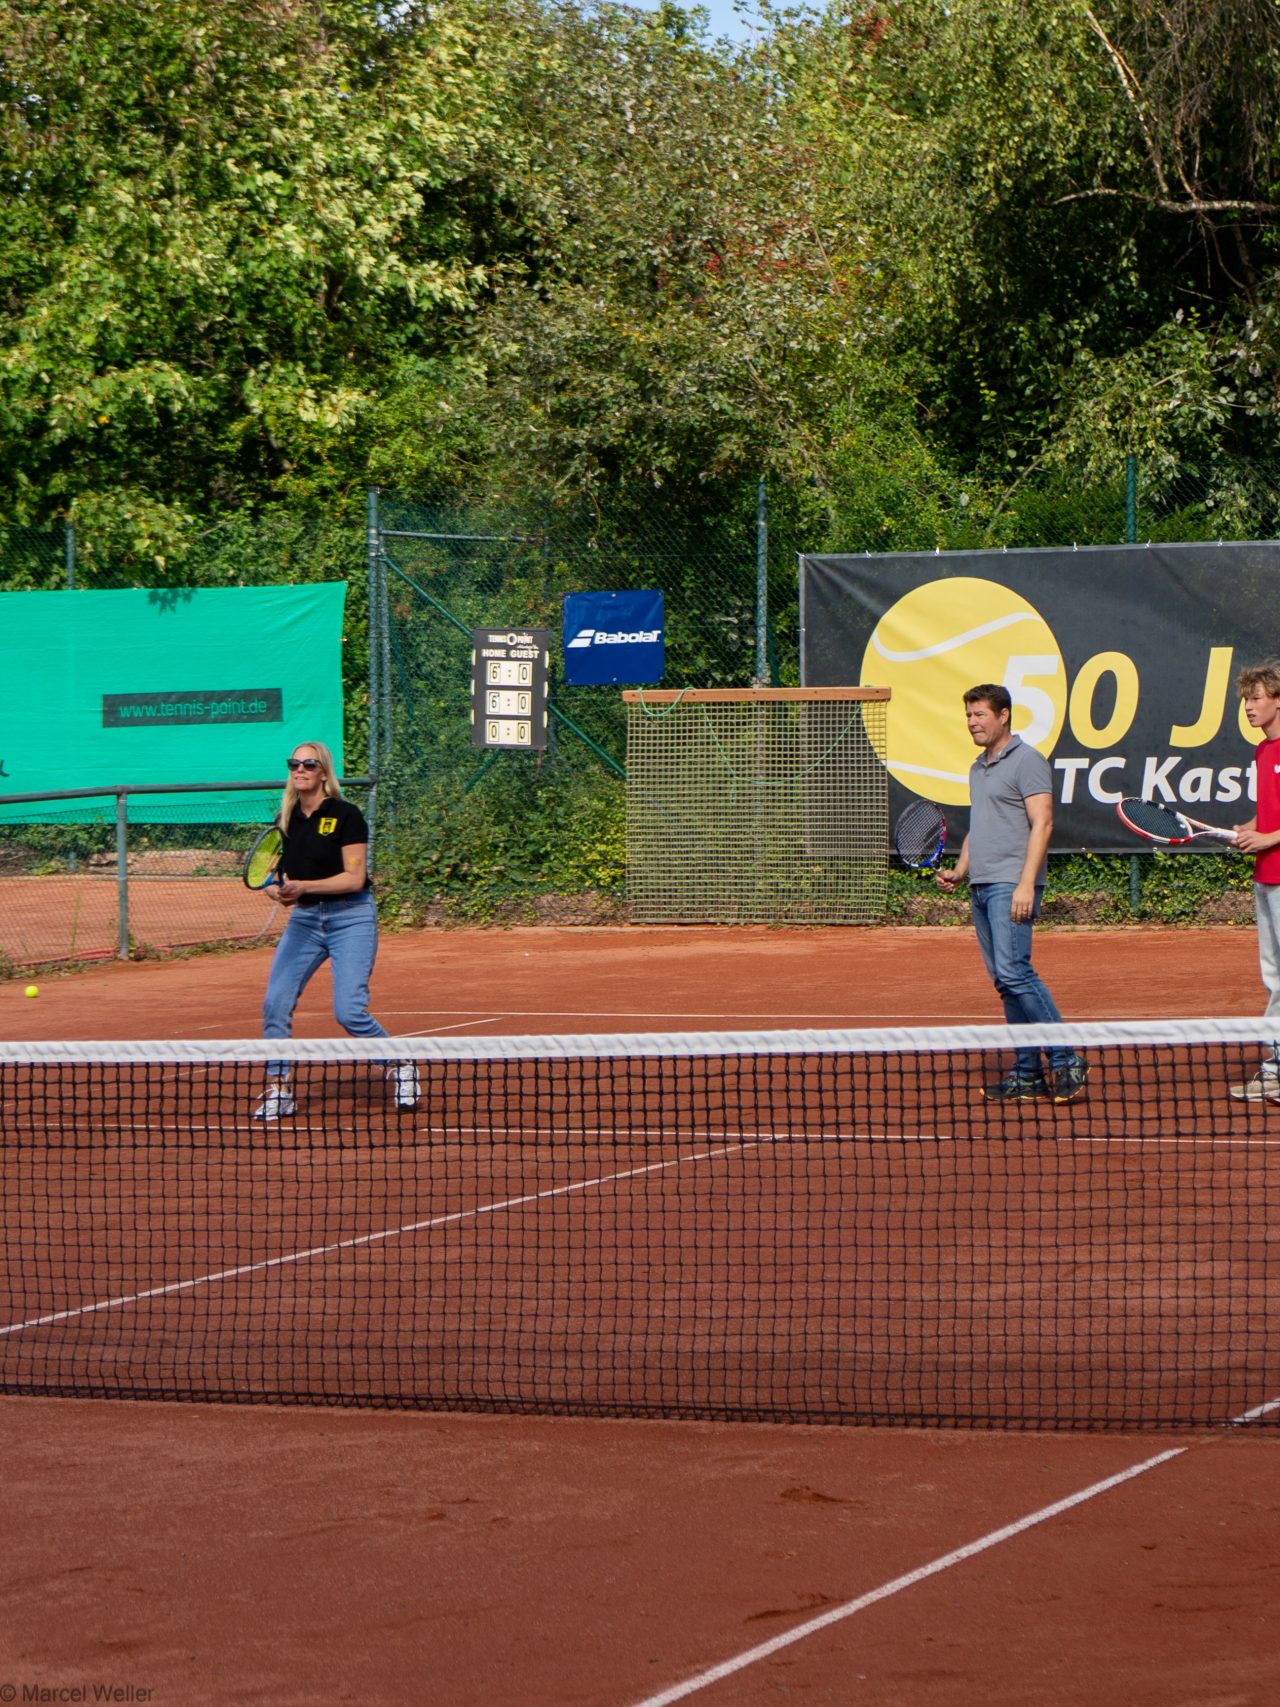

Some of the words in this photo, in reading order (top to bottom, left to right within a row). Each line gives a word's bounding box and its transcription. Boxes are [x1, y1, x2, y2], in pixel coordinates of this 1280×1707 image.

[482, 649, 506, 657] HOME
[510, 649, 539, 658] GUEST
[119, 699, 268, 719] www.tennis-point.de
[1003, 651, 1140, 750] 50
[1054, 757, 1126, 804] TC
